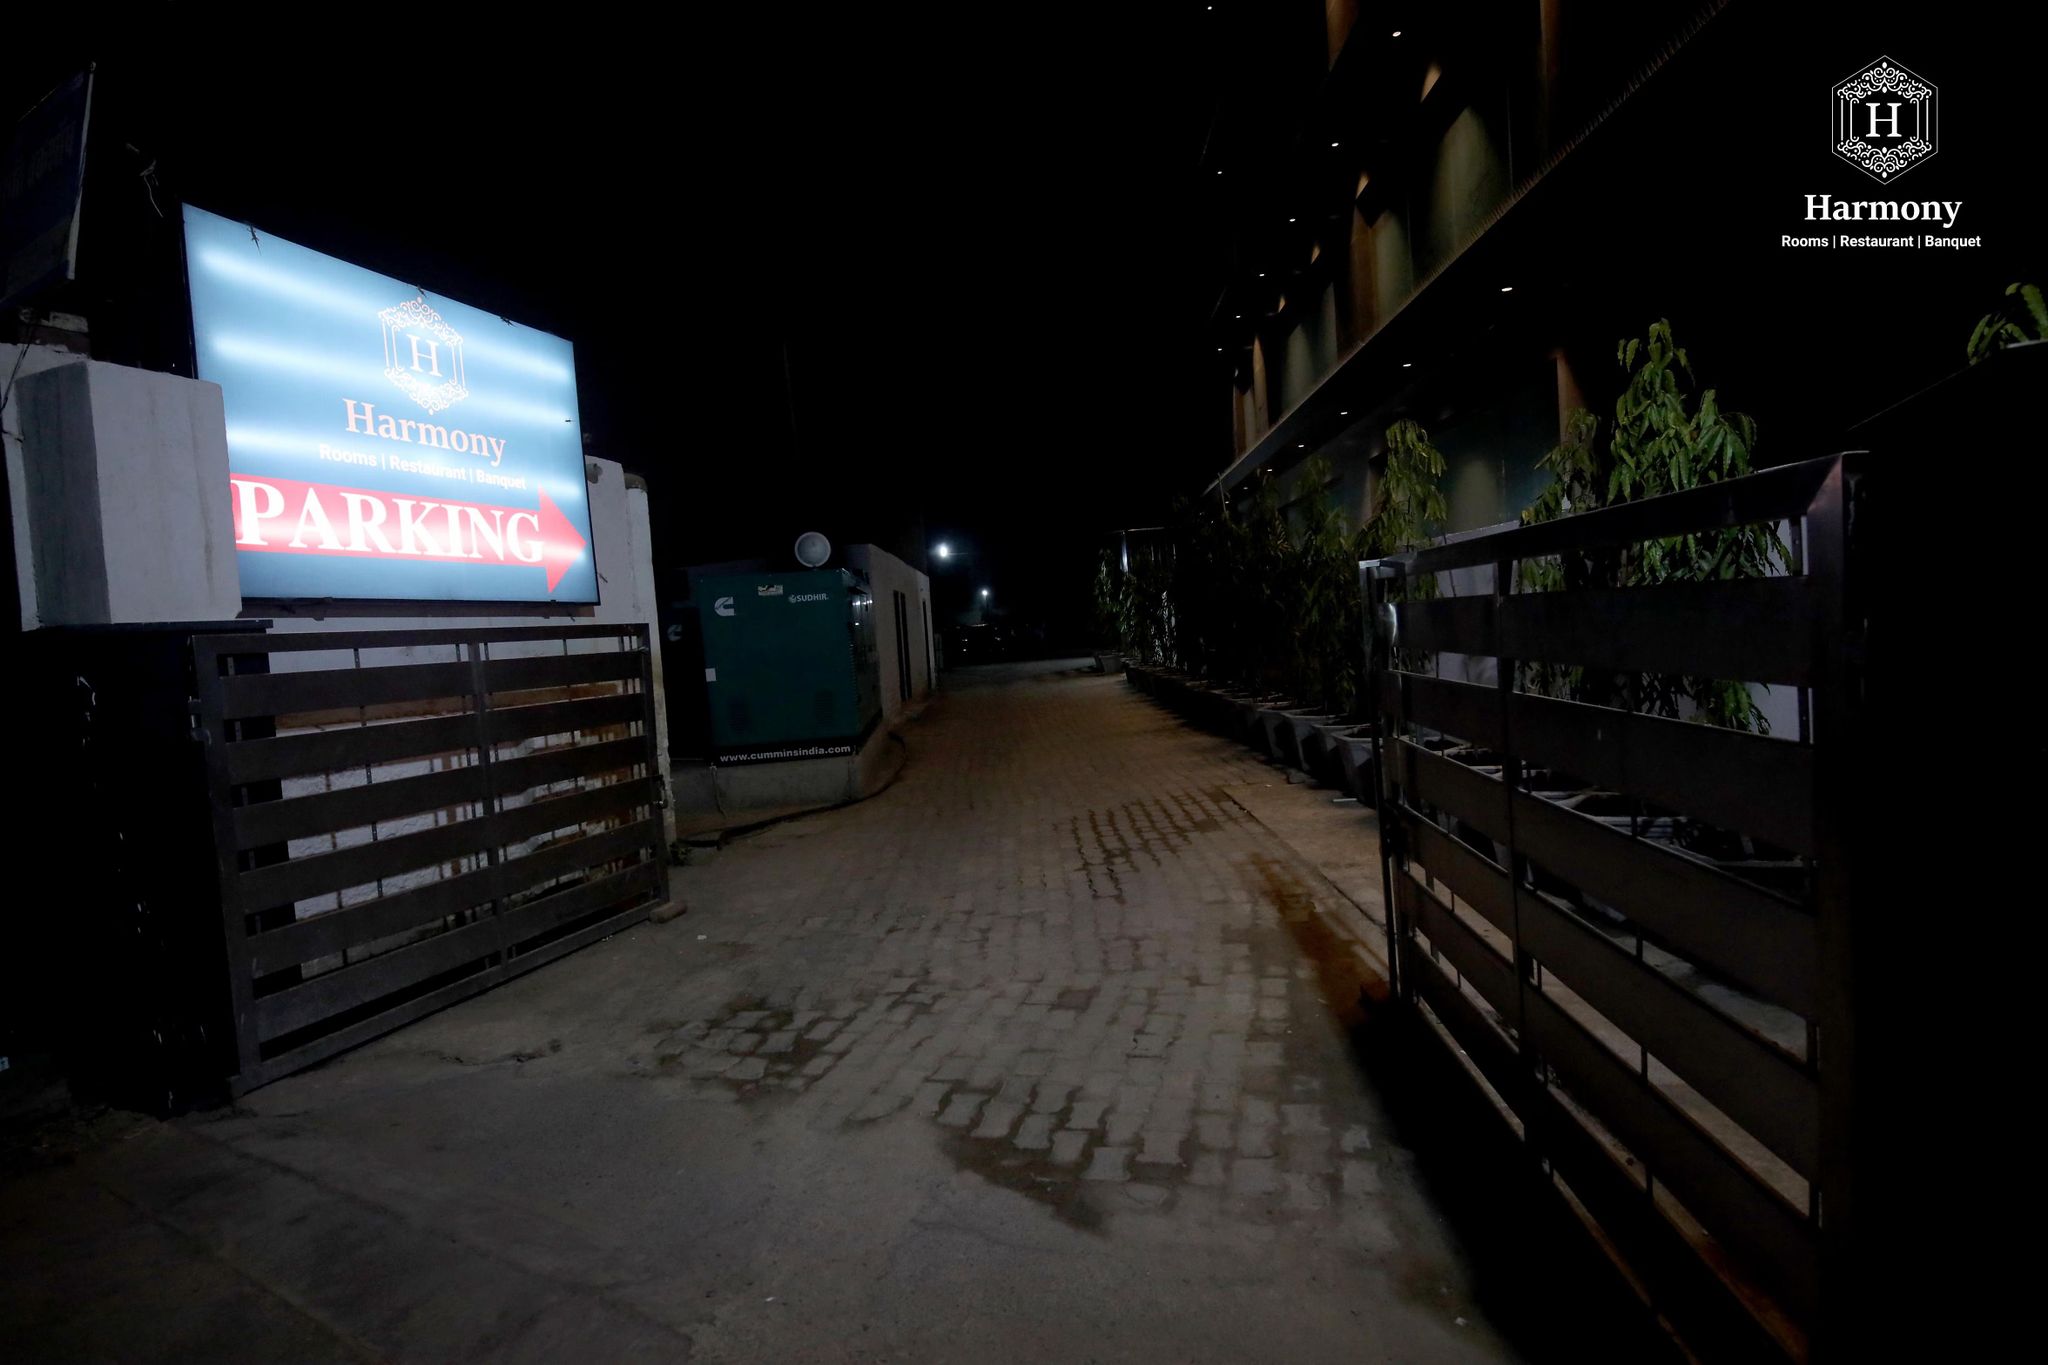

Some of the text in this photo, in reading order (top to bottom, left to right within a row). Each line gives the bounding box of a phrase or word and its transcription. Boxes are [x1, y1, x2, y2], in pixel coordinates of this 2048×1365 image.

[407, 334, 442, 377] H
[342, 398, 506, 467] Harmony
[319, 444, 527, 490] Rooms Restaurant Banquet
[230, 478, 546, 563] PARKING
[796, 593, 828, 602] SUDHIR
[720, 745, 851, 762] www.cumminsindia.com
